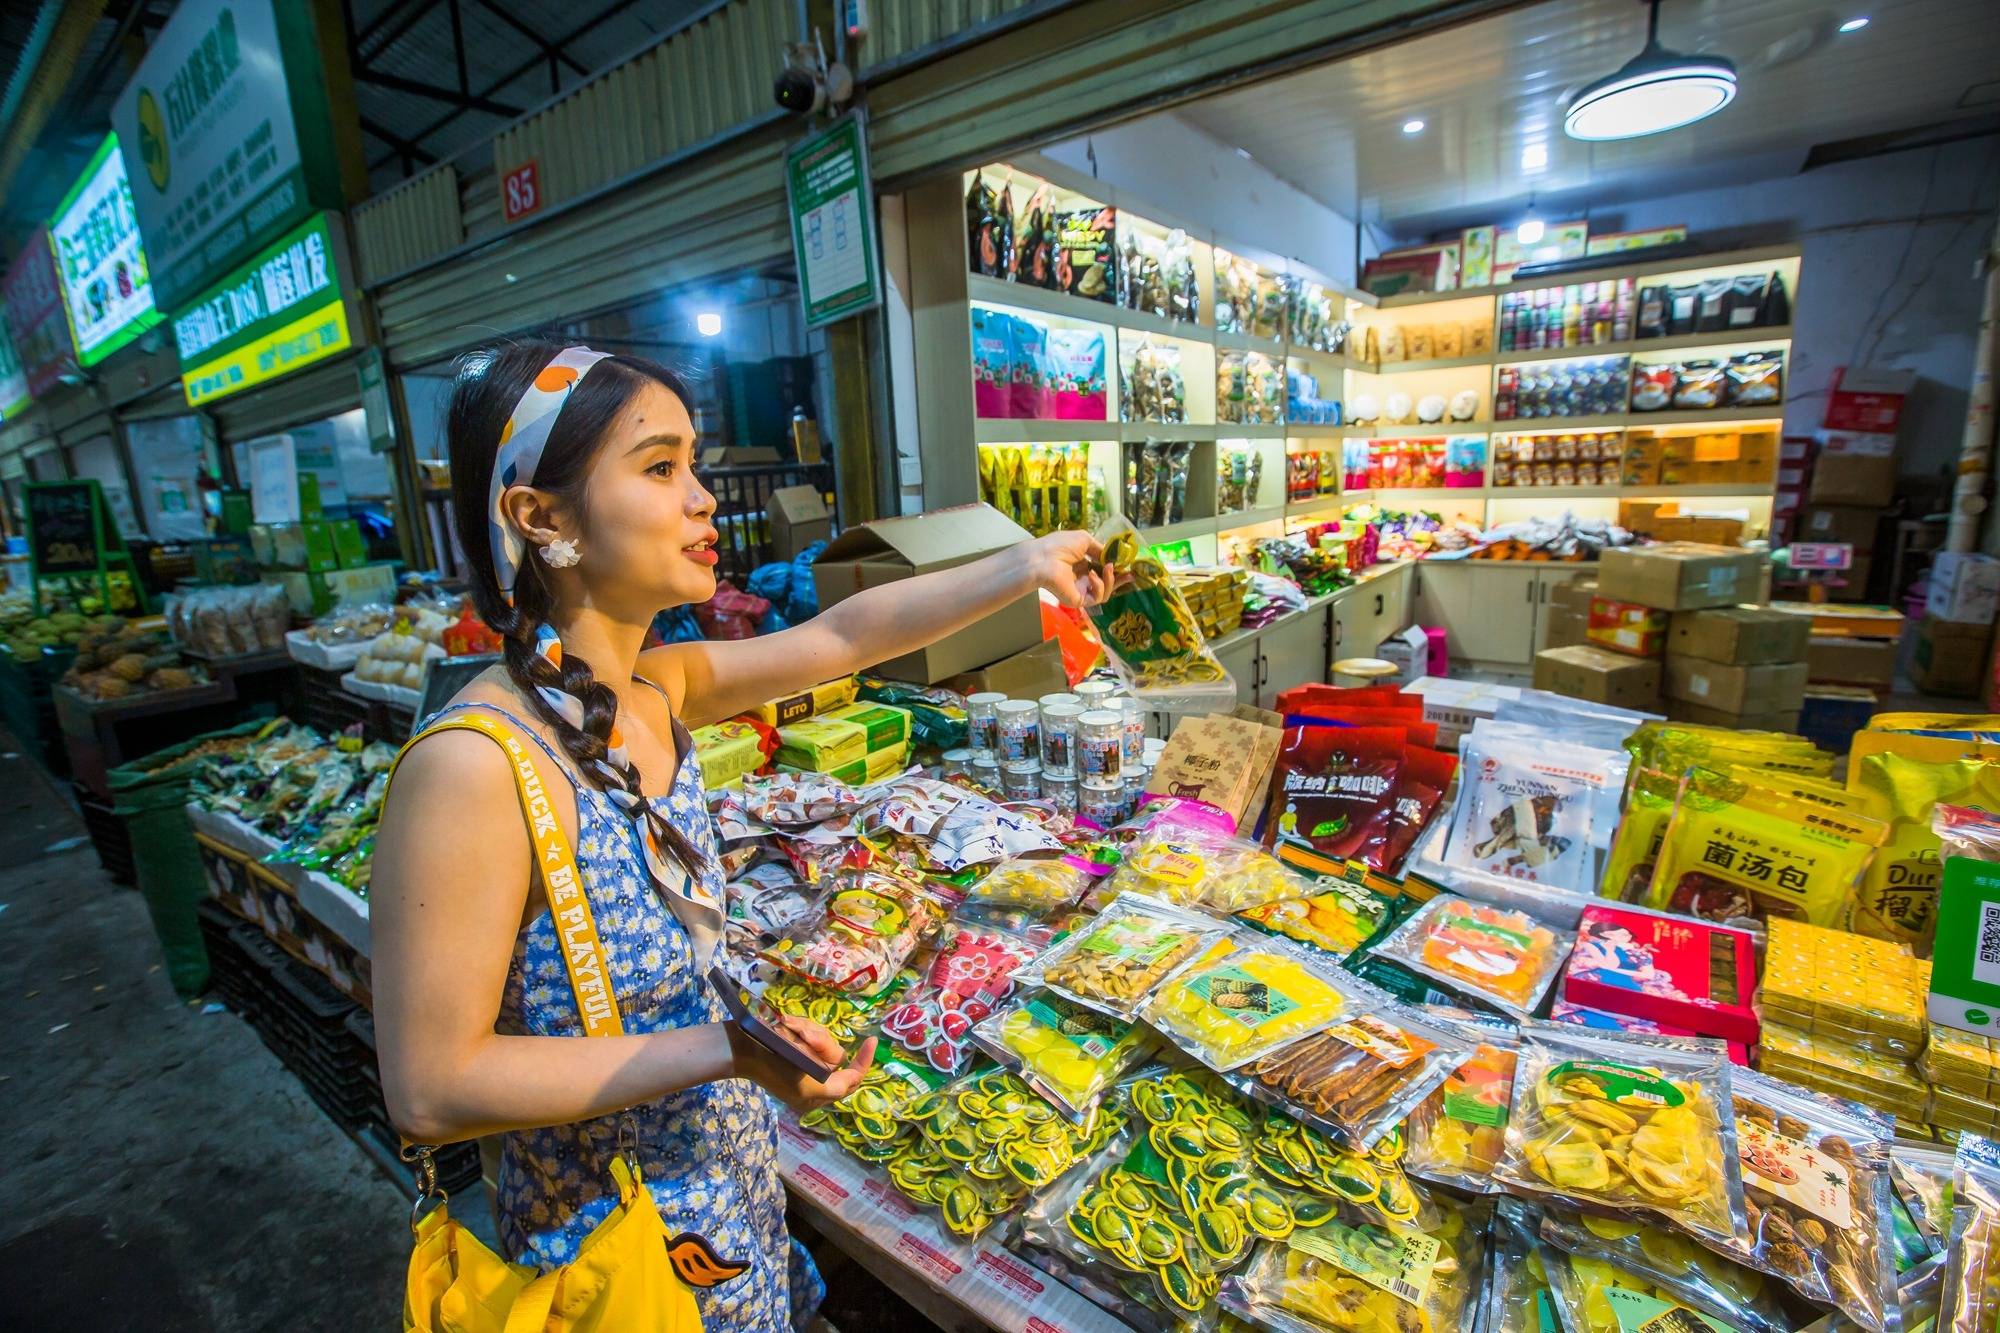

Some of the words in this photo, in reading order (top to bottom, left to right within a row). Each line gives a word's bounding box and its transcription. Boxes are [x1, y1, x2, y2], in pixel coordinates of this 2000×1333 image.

[507, 169, 535, 214] 85
[783, 702, 808, 719] LETO
[548, 864, 580, 906] BE
[1702, 840, 1810, 894] 菌汤包
[560, 904, 613, 1030] PLAYFUL
